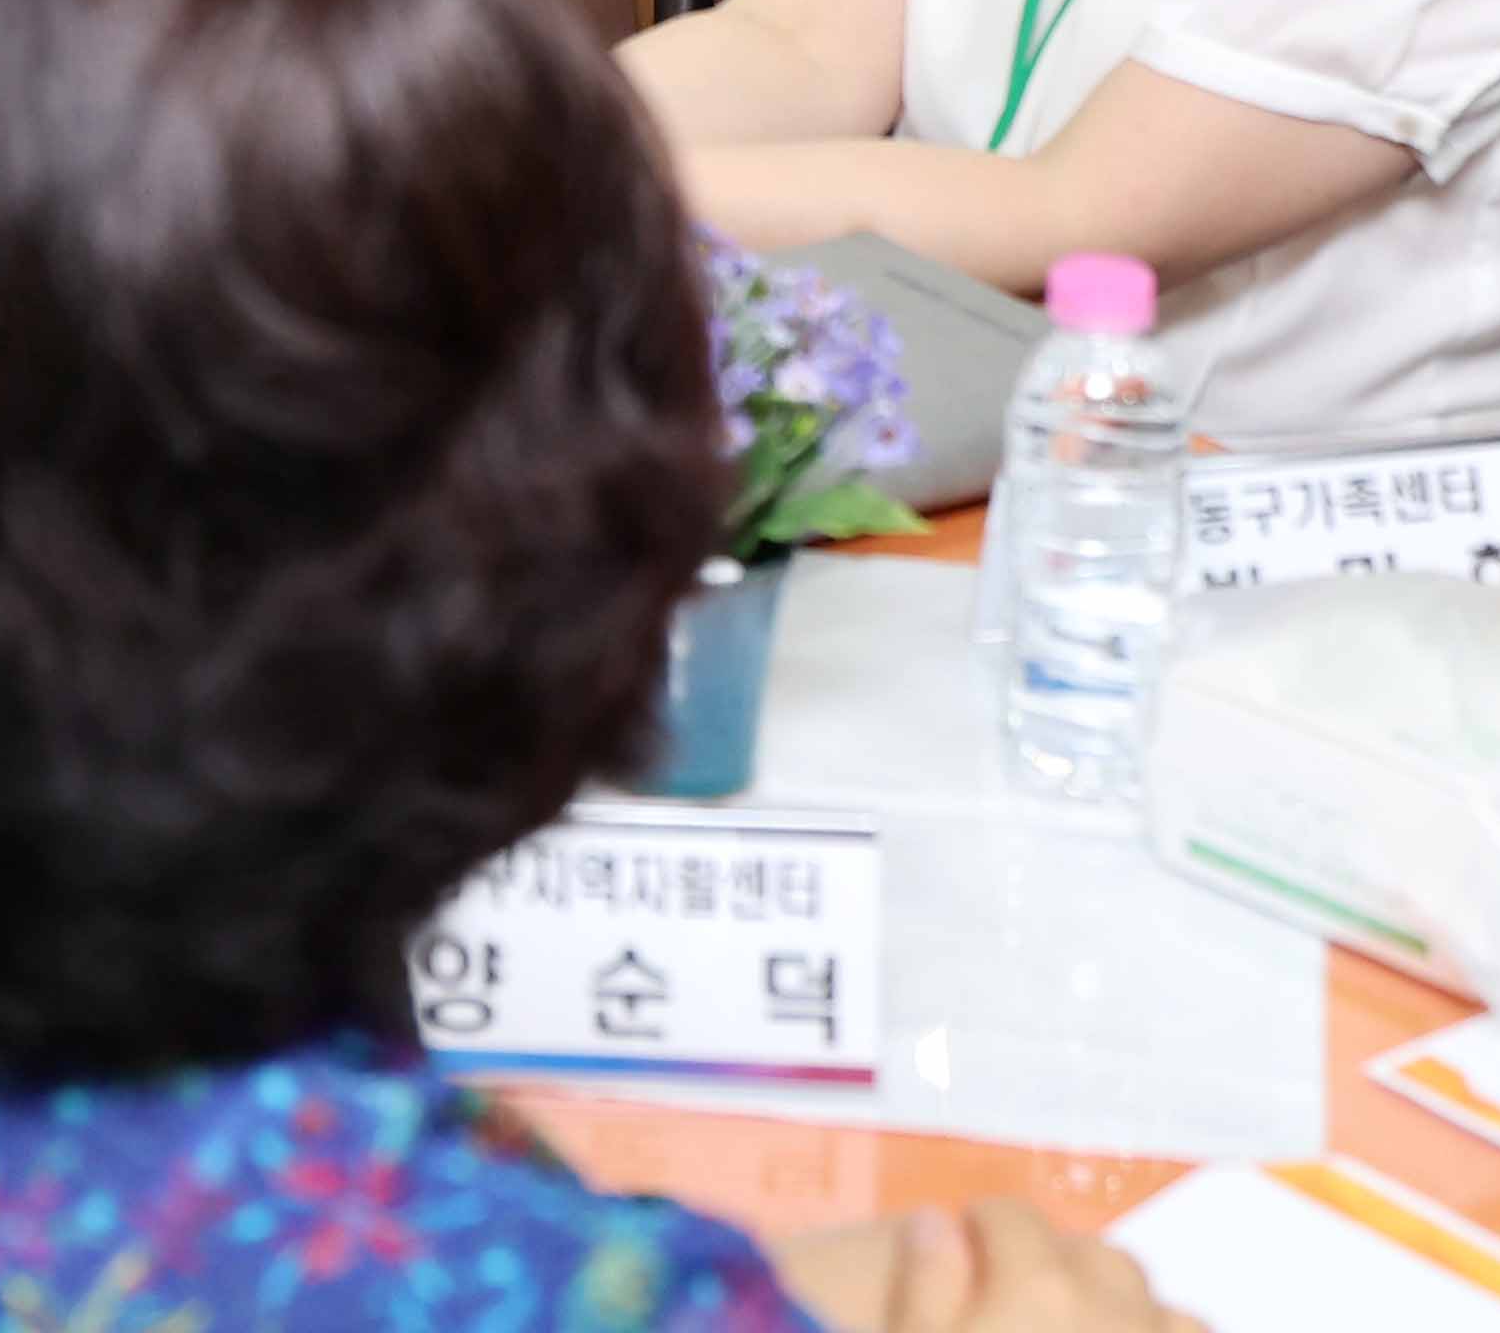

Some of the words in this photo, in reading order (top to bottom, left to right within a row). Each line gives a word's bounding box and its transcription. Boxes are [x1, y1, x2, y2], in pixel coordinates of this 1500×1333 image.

[1190, 465, 1484, 544] 동구가족센터
[419, 935, 500, 1033] 양
[592, 947, 670, 1041] 순
[764, 951, 838, 1045] 덕
